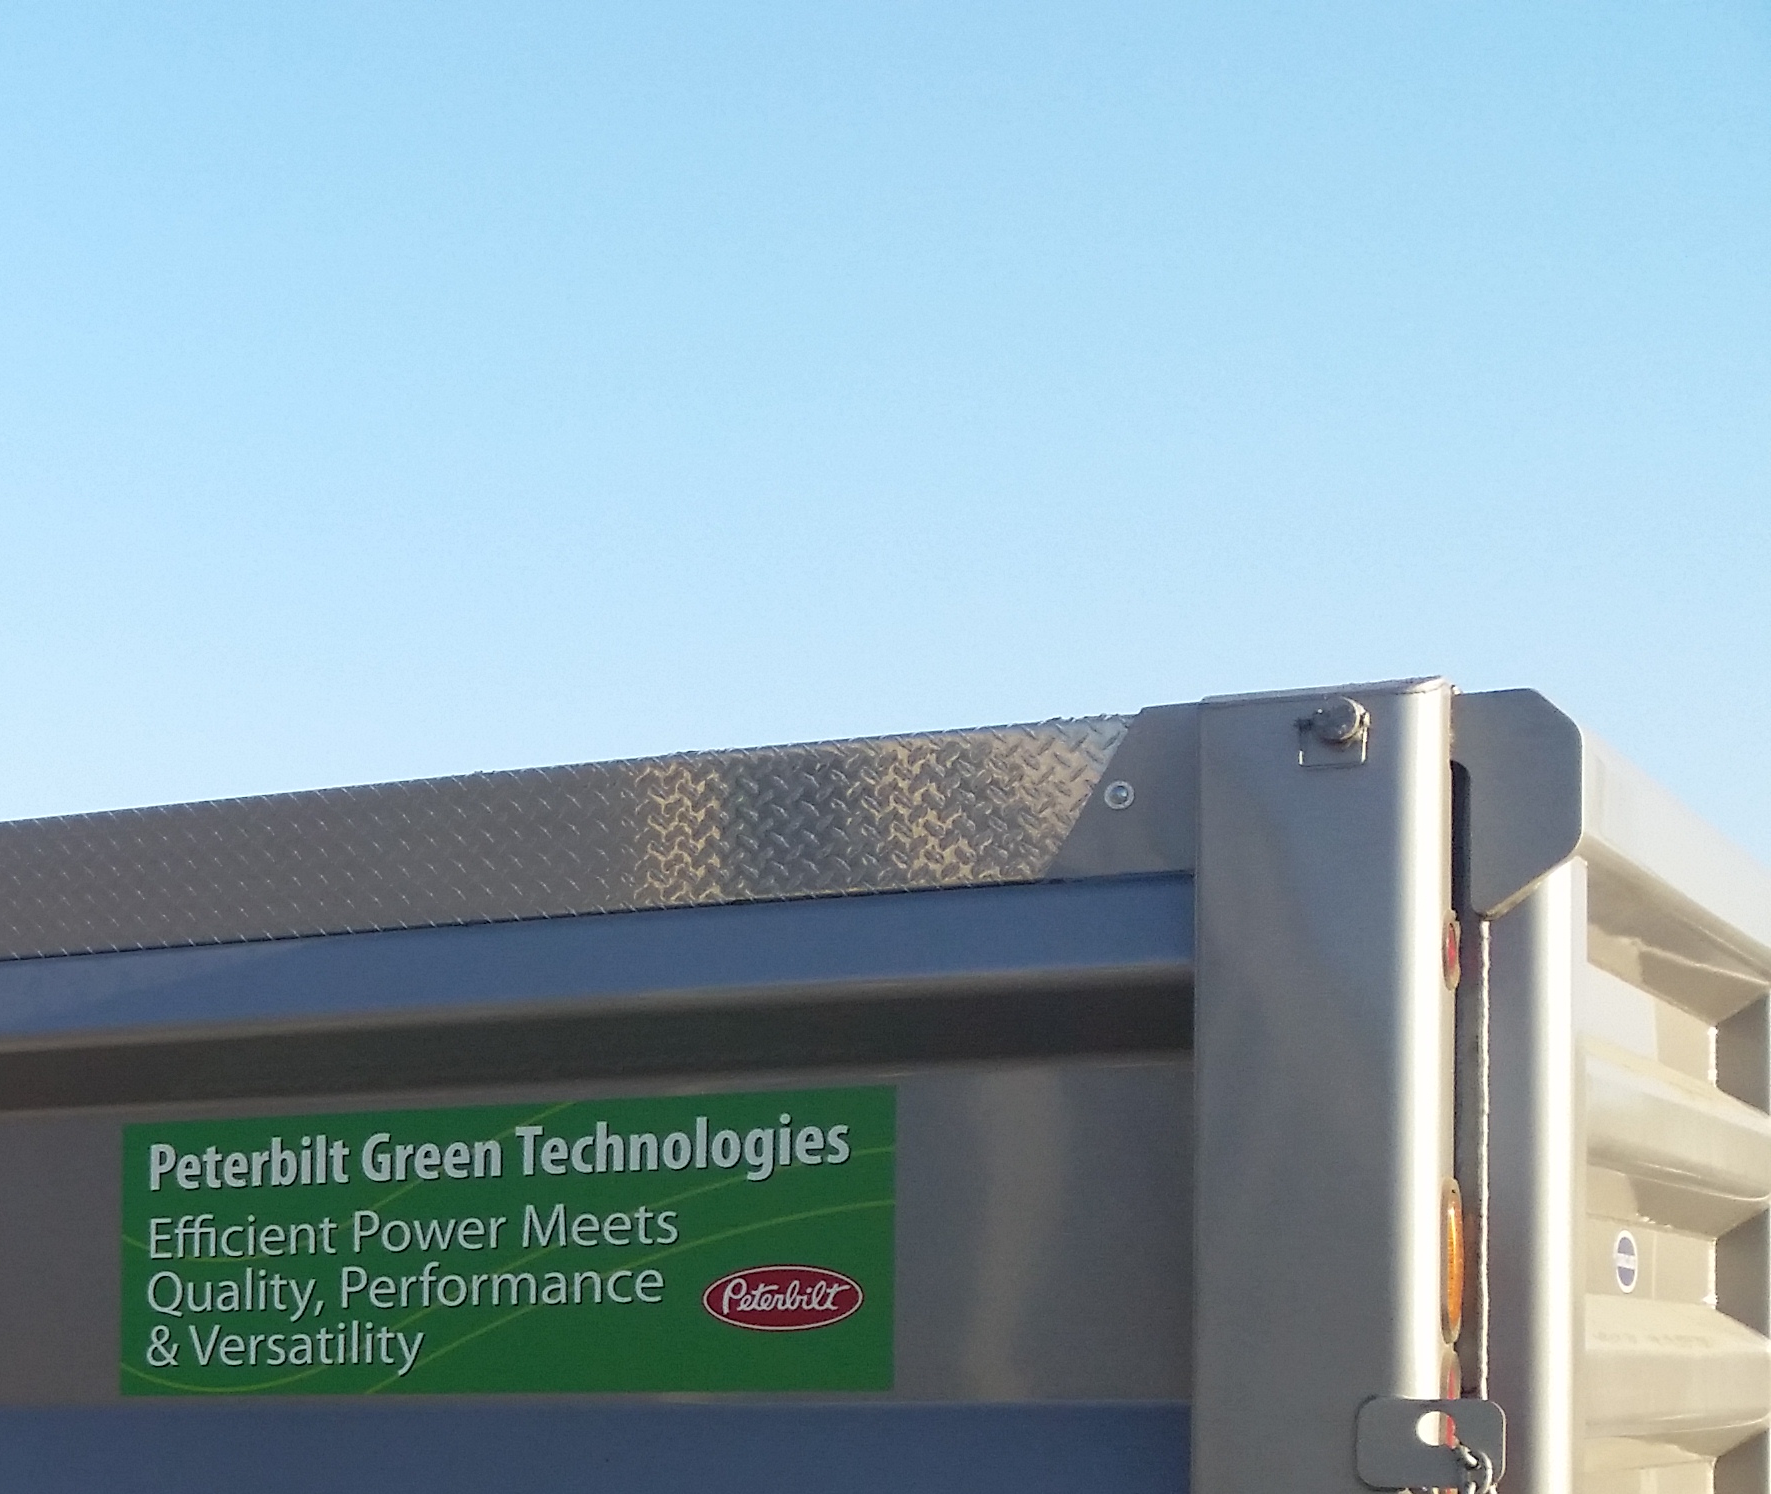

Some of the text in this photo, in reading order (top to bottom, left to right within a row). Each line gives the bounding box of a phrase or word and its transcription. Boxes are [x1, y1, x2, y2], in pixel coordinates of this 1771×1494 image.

[149, 1114, 852, 1191] Peterbilt Green Technologies
[149, 1203, 680, 1260] Efficient Power Meets
[146, 1261, 665, 1322] Quality, Performance
[721, 1279, 847, 1317] Peterbilt
[145, 1320, 426, 1376] & Versatility
